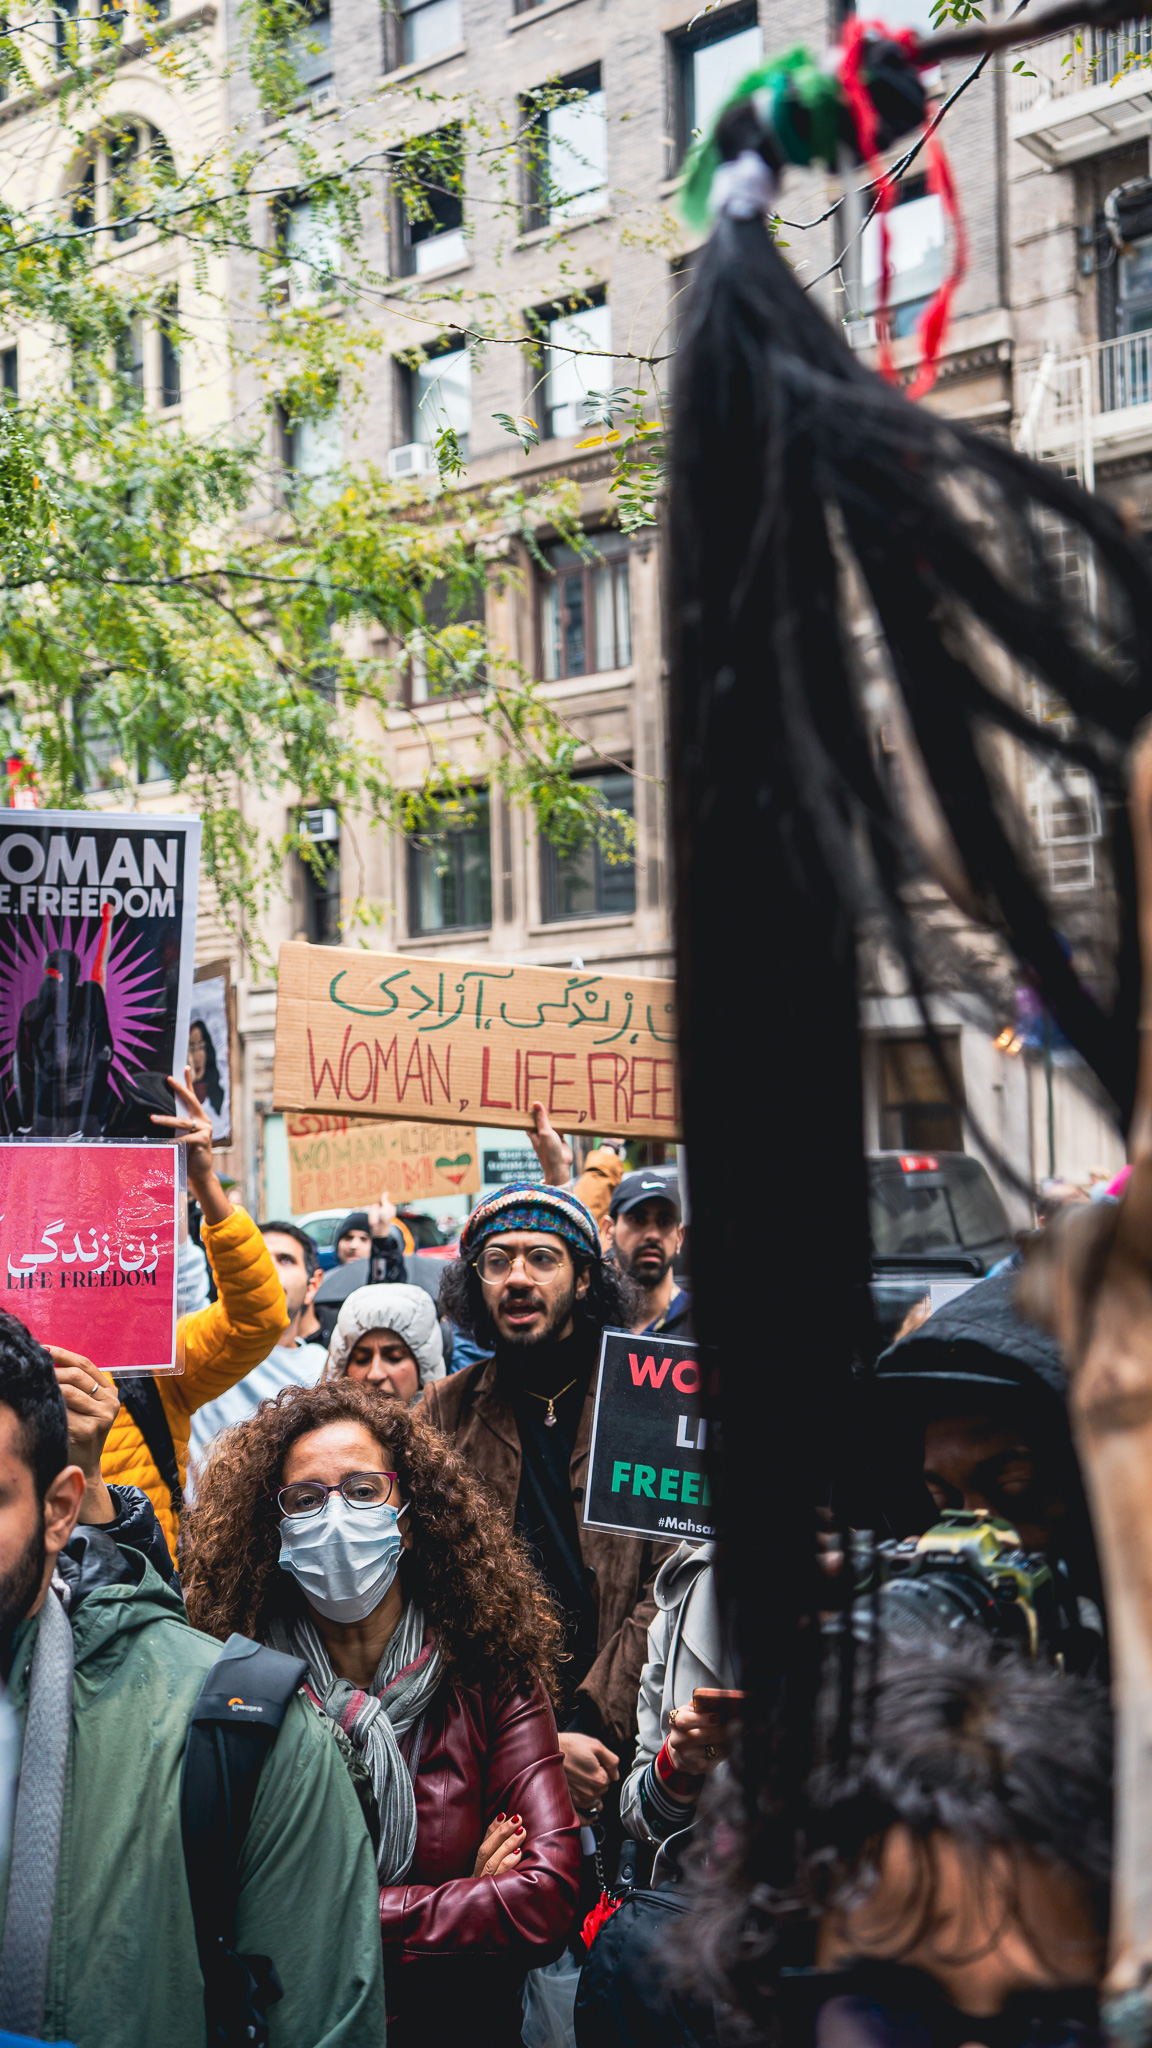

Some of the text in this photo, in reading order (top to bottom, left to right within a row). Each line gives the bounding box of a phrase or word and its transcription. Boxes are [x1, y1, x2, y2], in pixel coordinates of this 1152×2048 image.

[0, 833, 178, 887] OMAN
[330, 969, 514, 1032] آزادی
[307, 1024, 681, 1124] WOMAN, LIFE, FREE
[292, 1125, 464, 1171] WOMAN LIFE
[297, 1156, 435, 1210] FREEDOM!
[7, 1219, 159, 1278] زن زندگی
[7, 1269, 157, 1290] LIFE FREEDOM
[628, 1353, 704, 1395] WO
[676, 1414, 708, 1451] LI
[658, 1516, 716, 1536] #Mahsa
